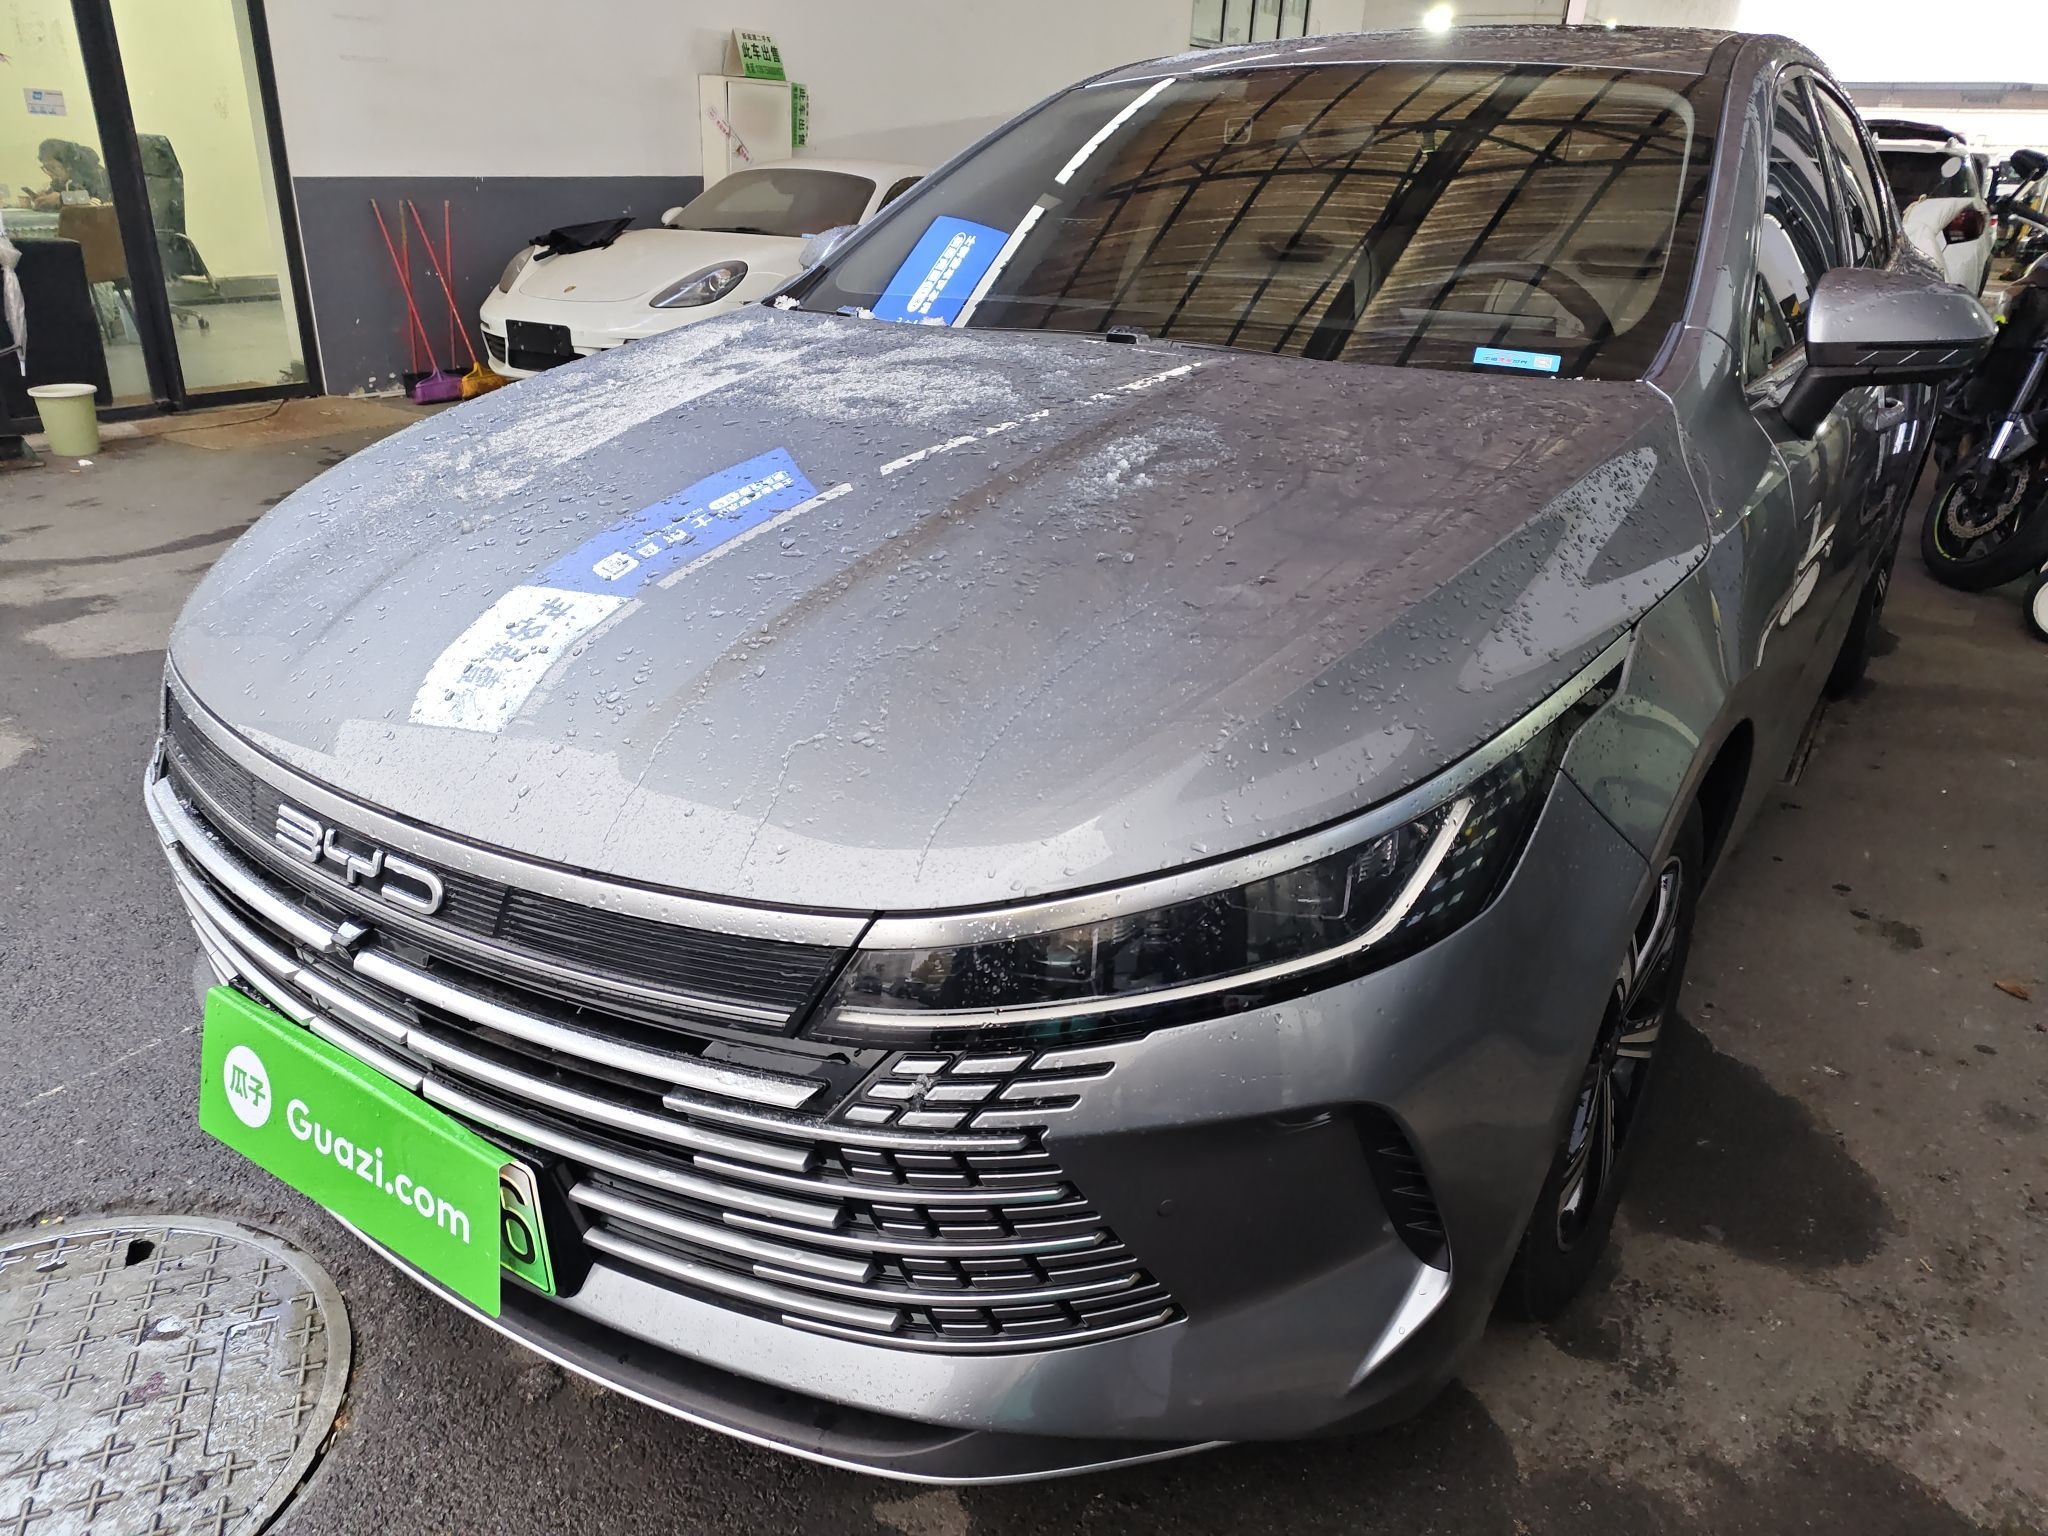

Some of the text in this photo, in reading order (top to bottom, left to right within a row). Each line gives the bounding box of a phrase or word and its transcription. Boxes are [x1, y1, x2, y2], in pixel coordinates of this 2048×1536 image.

[741, 42, 781, 63] 此车出售
[275, 803, 444, 915] BYD
[230, 1063, 267, 1107] 瓜子
[286, 1098, 471, 1245] Guazi.com
